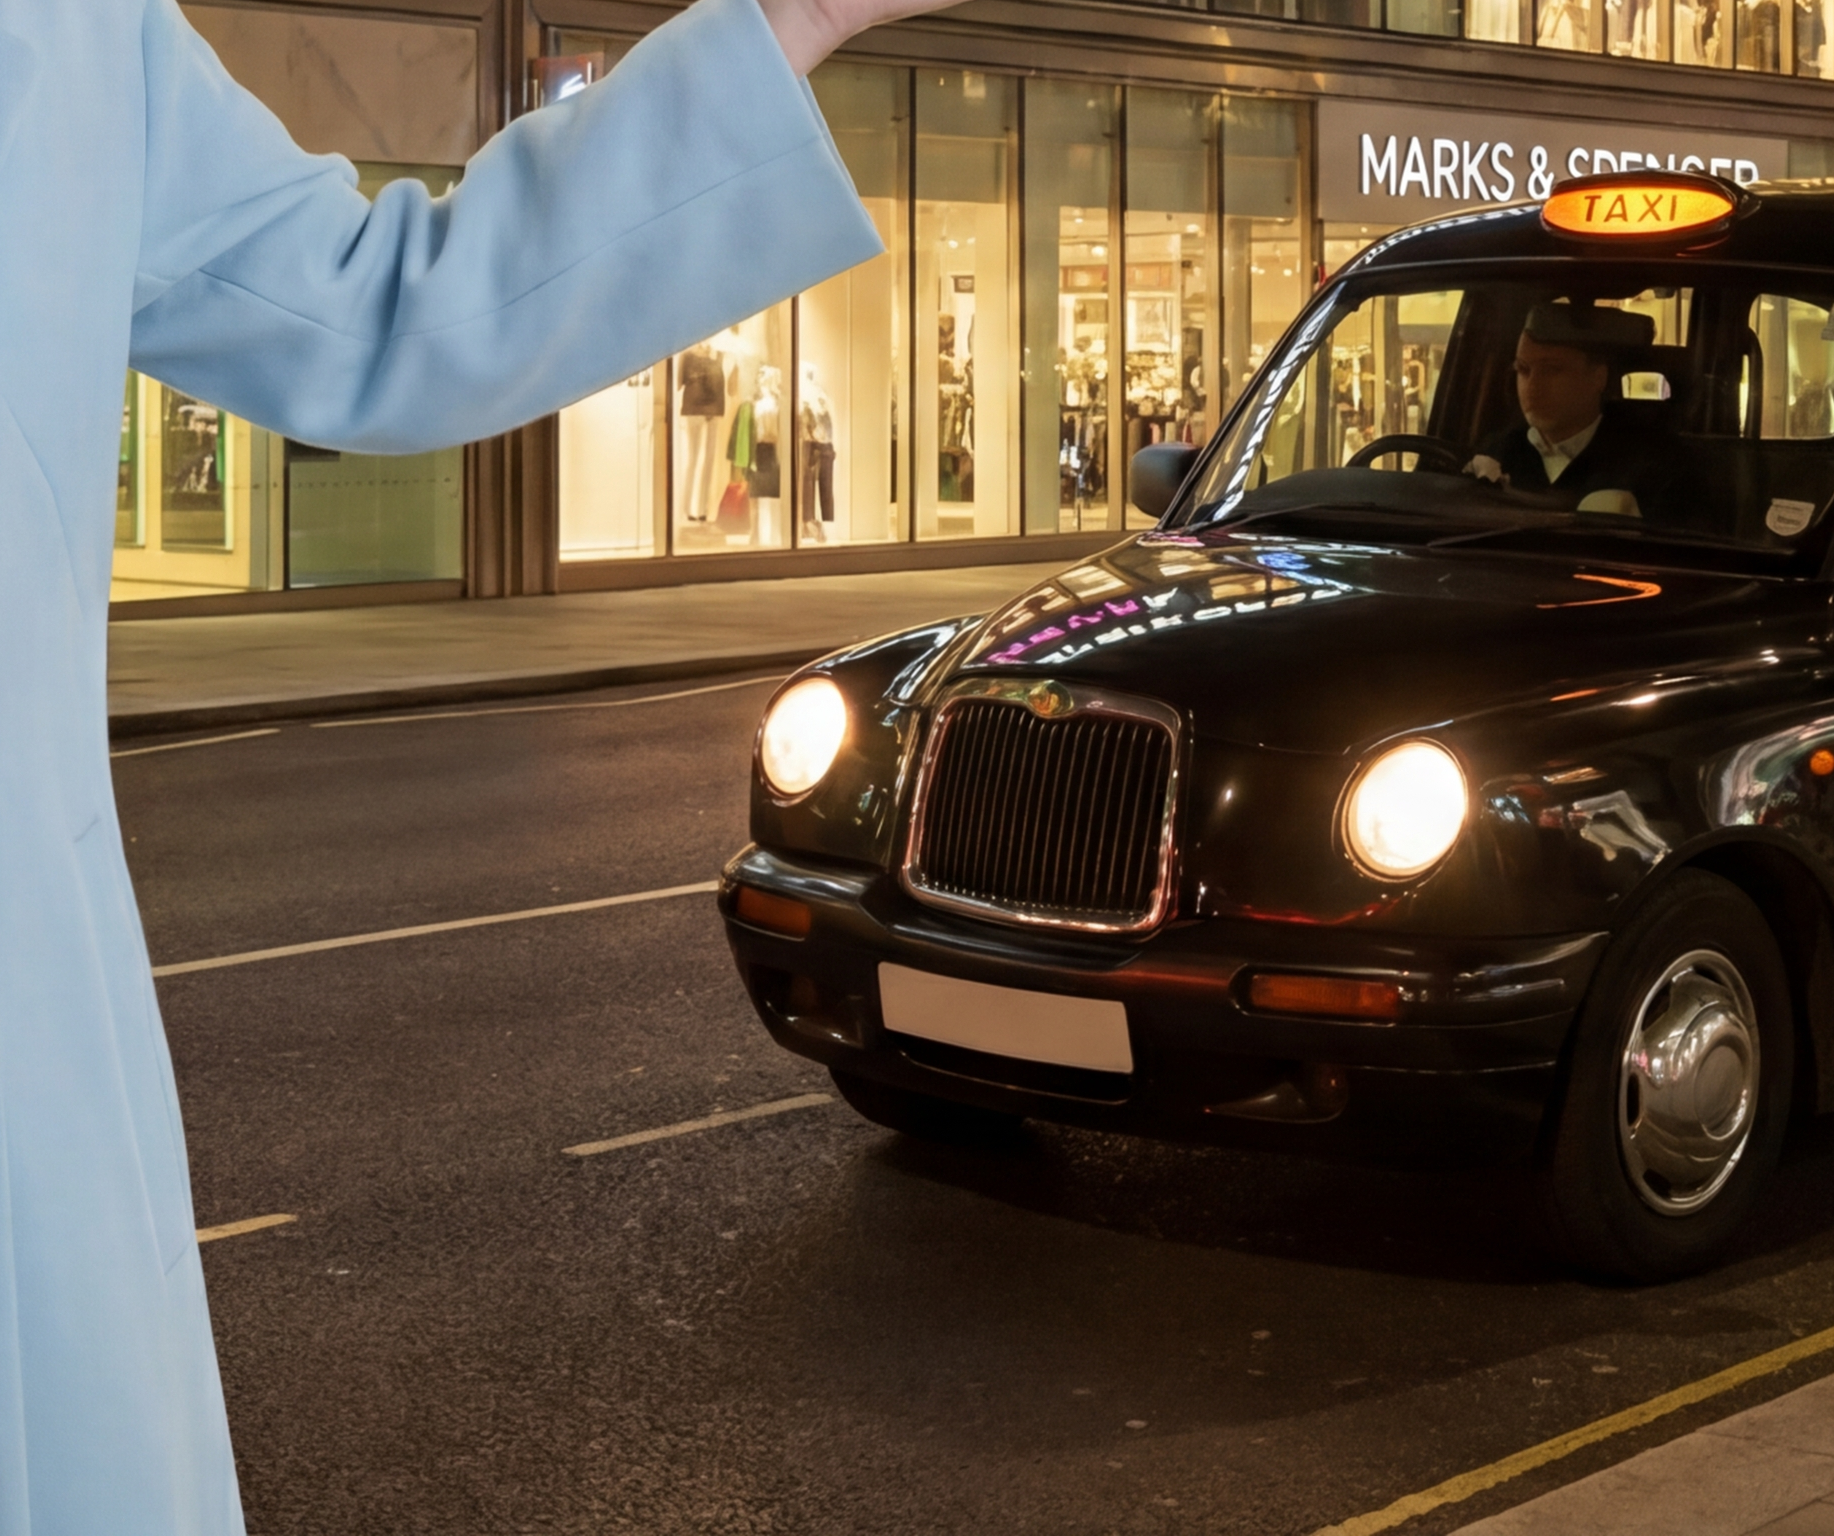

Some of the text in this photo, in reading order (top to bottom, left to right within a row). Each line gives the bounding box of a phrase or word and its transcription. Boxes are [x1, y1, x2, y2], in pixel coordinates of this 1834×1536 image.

[1361, 132, 1515, 203] MARKS
[1527, 145, 1555, 200] &
[1584, 194, 1678, 223] TAXI
